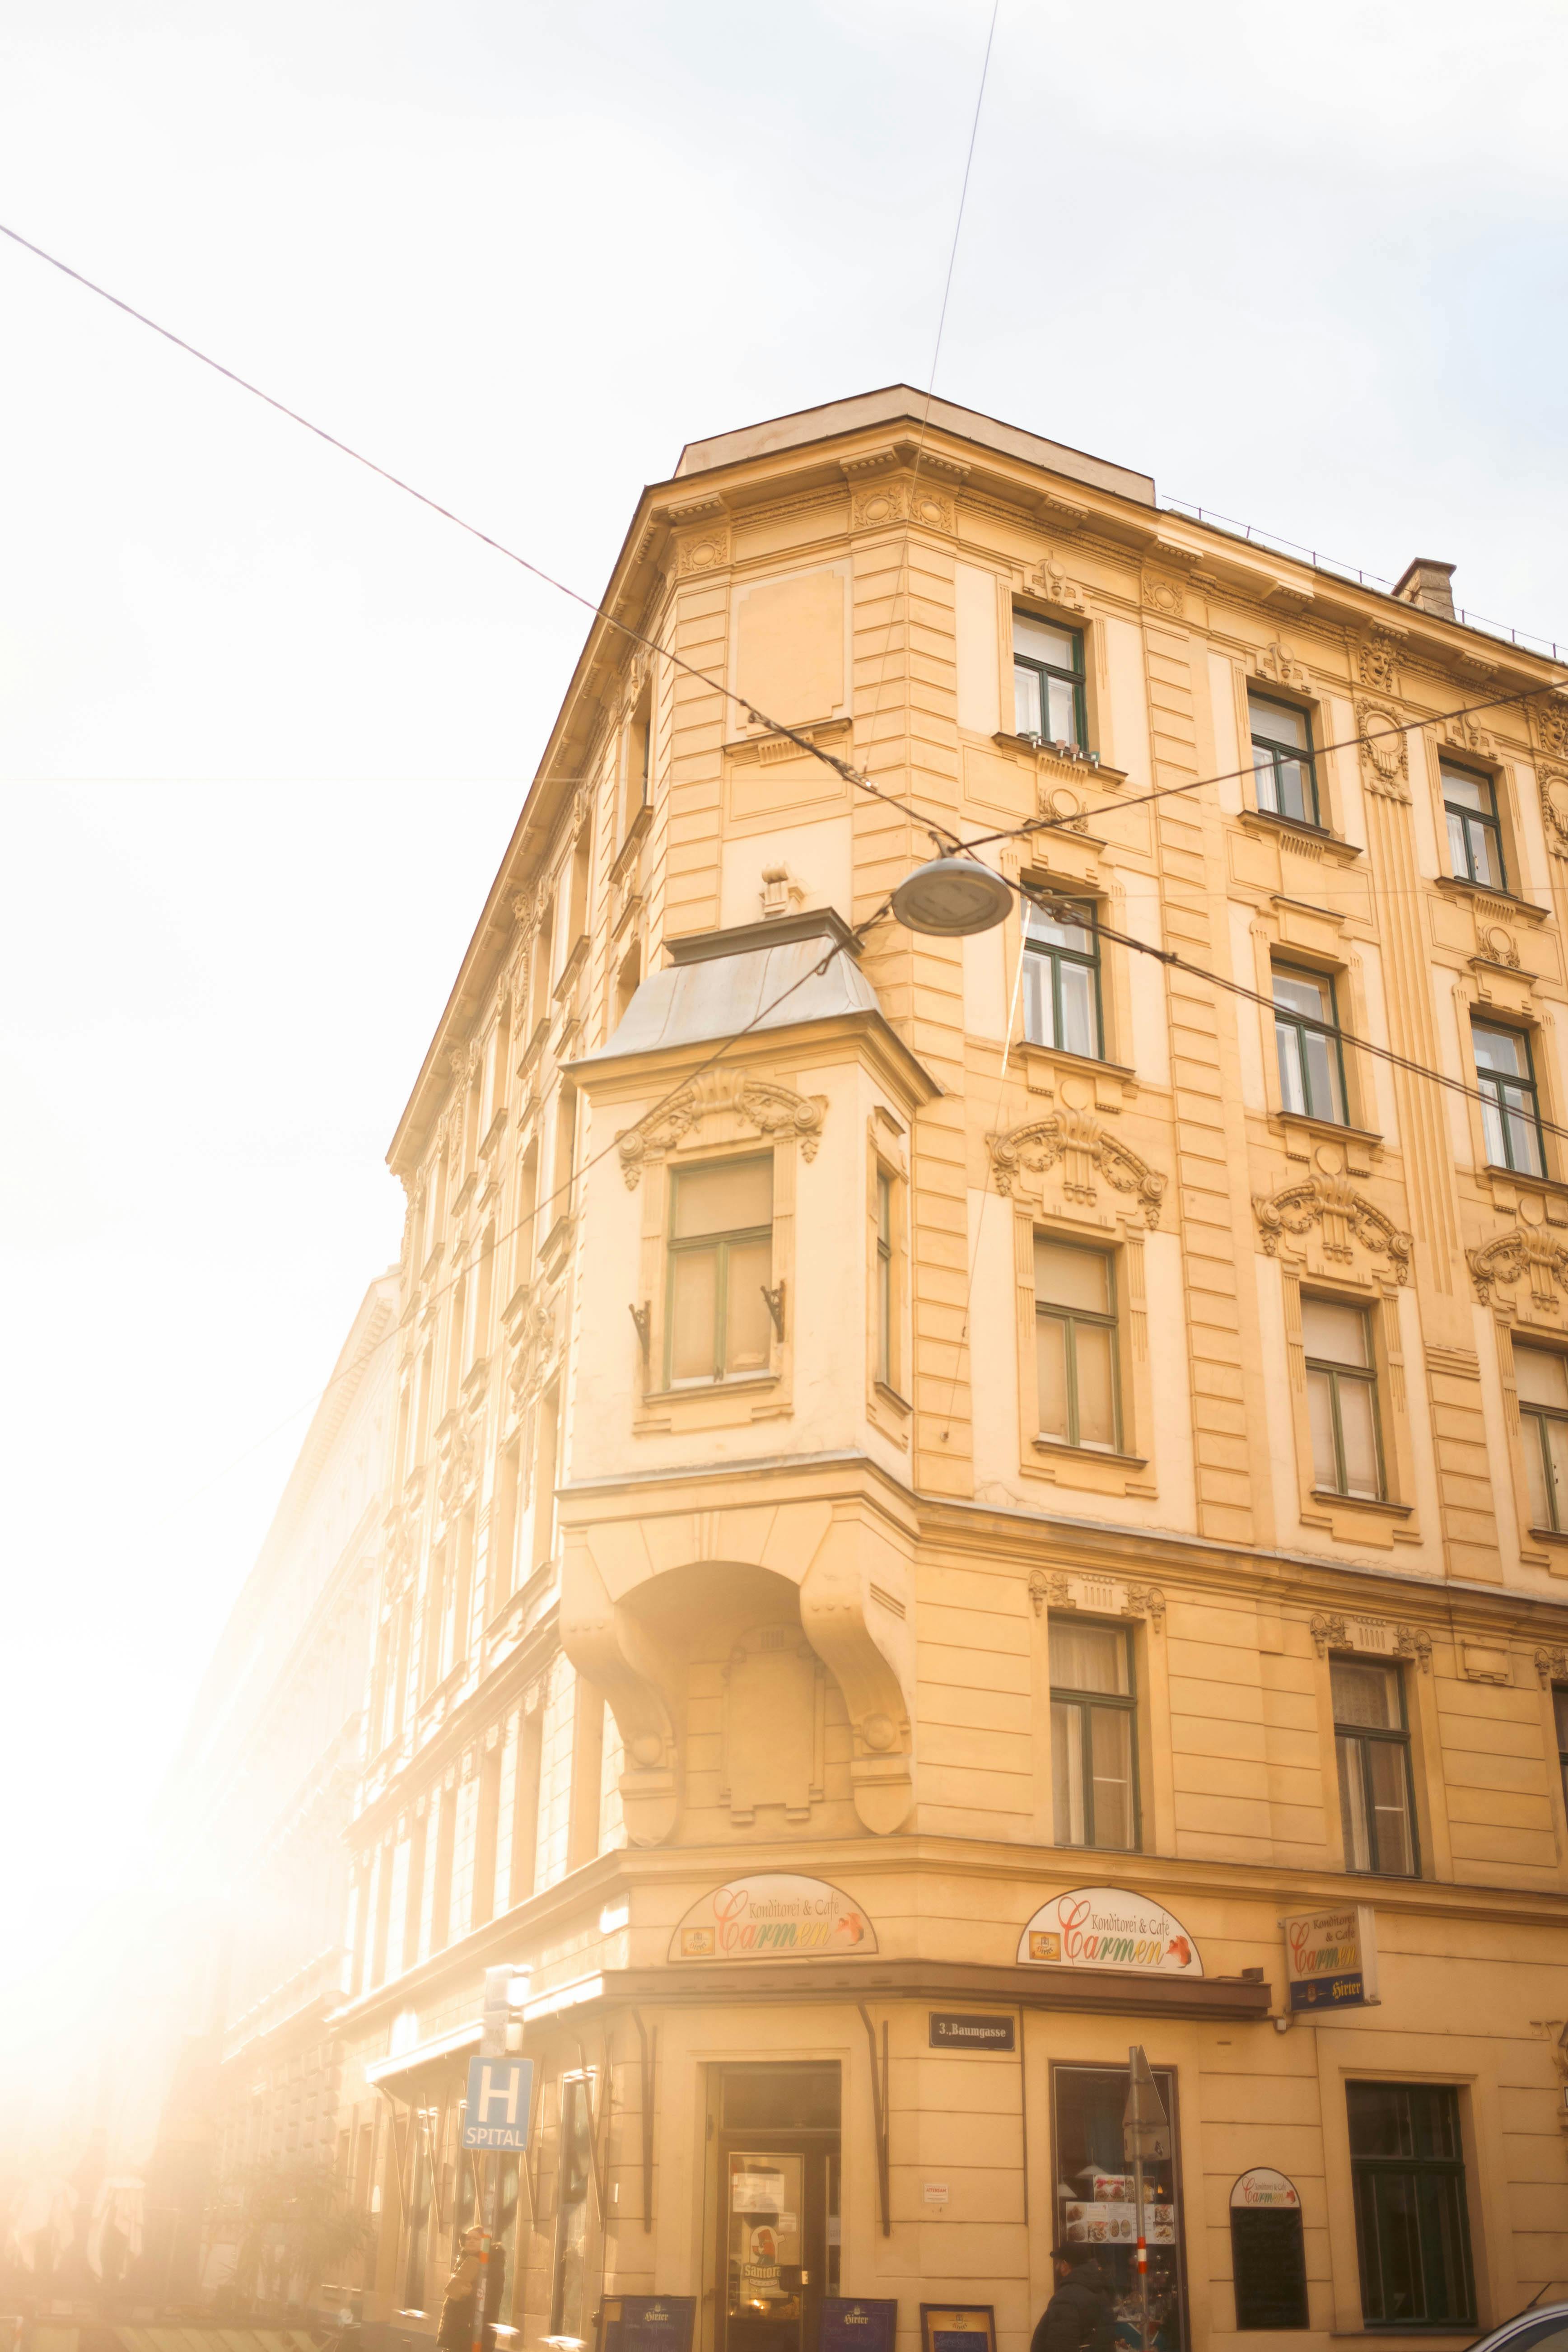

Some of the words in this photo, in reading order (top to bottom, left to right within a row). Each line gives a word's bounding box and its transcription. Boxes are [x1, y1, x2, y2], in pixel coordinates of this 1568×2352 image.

[749, 1898, 800, 1918] Konditorei
[803, 1901, 812, 1915] &
[815, 1891, 839, 1920] Café
[714, 1889, 832, 1958] Carmen
[1058, 1896, 1165, 1965] Carmen
[1092, 1913, 1136, 1933] Konditorei
[1139, 1918, 1147, 1934] &
[1149, 1913, 1170, 1942] Café
[1313, 1912, 1355, 1929] Konditorei
[1326, 1932, 1333, 1942] &
[1290, 1922, 1358, 1979] Carmen
[1333, 1980, 1361, 1999] Hirter
[952, 2023, 1006, 2039] Baumgasse
[478, 2066, 520, 2123] H
[466, 2127, 524, 2147] SPITAL
[1242, 2176, 1285, 2204] Carmen
[644, 2311, 669, 2321] Hirter
[844, 2314, 868, 2325] Hirter
